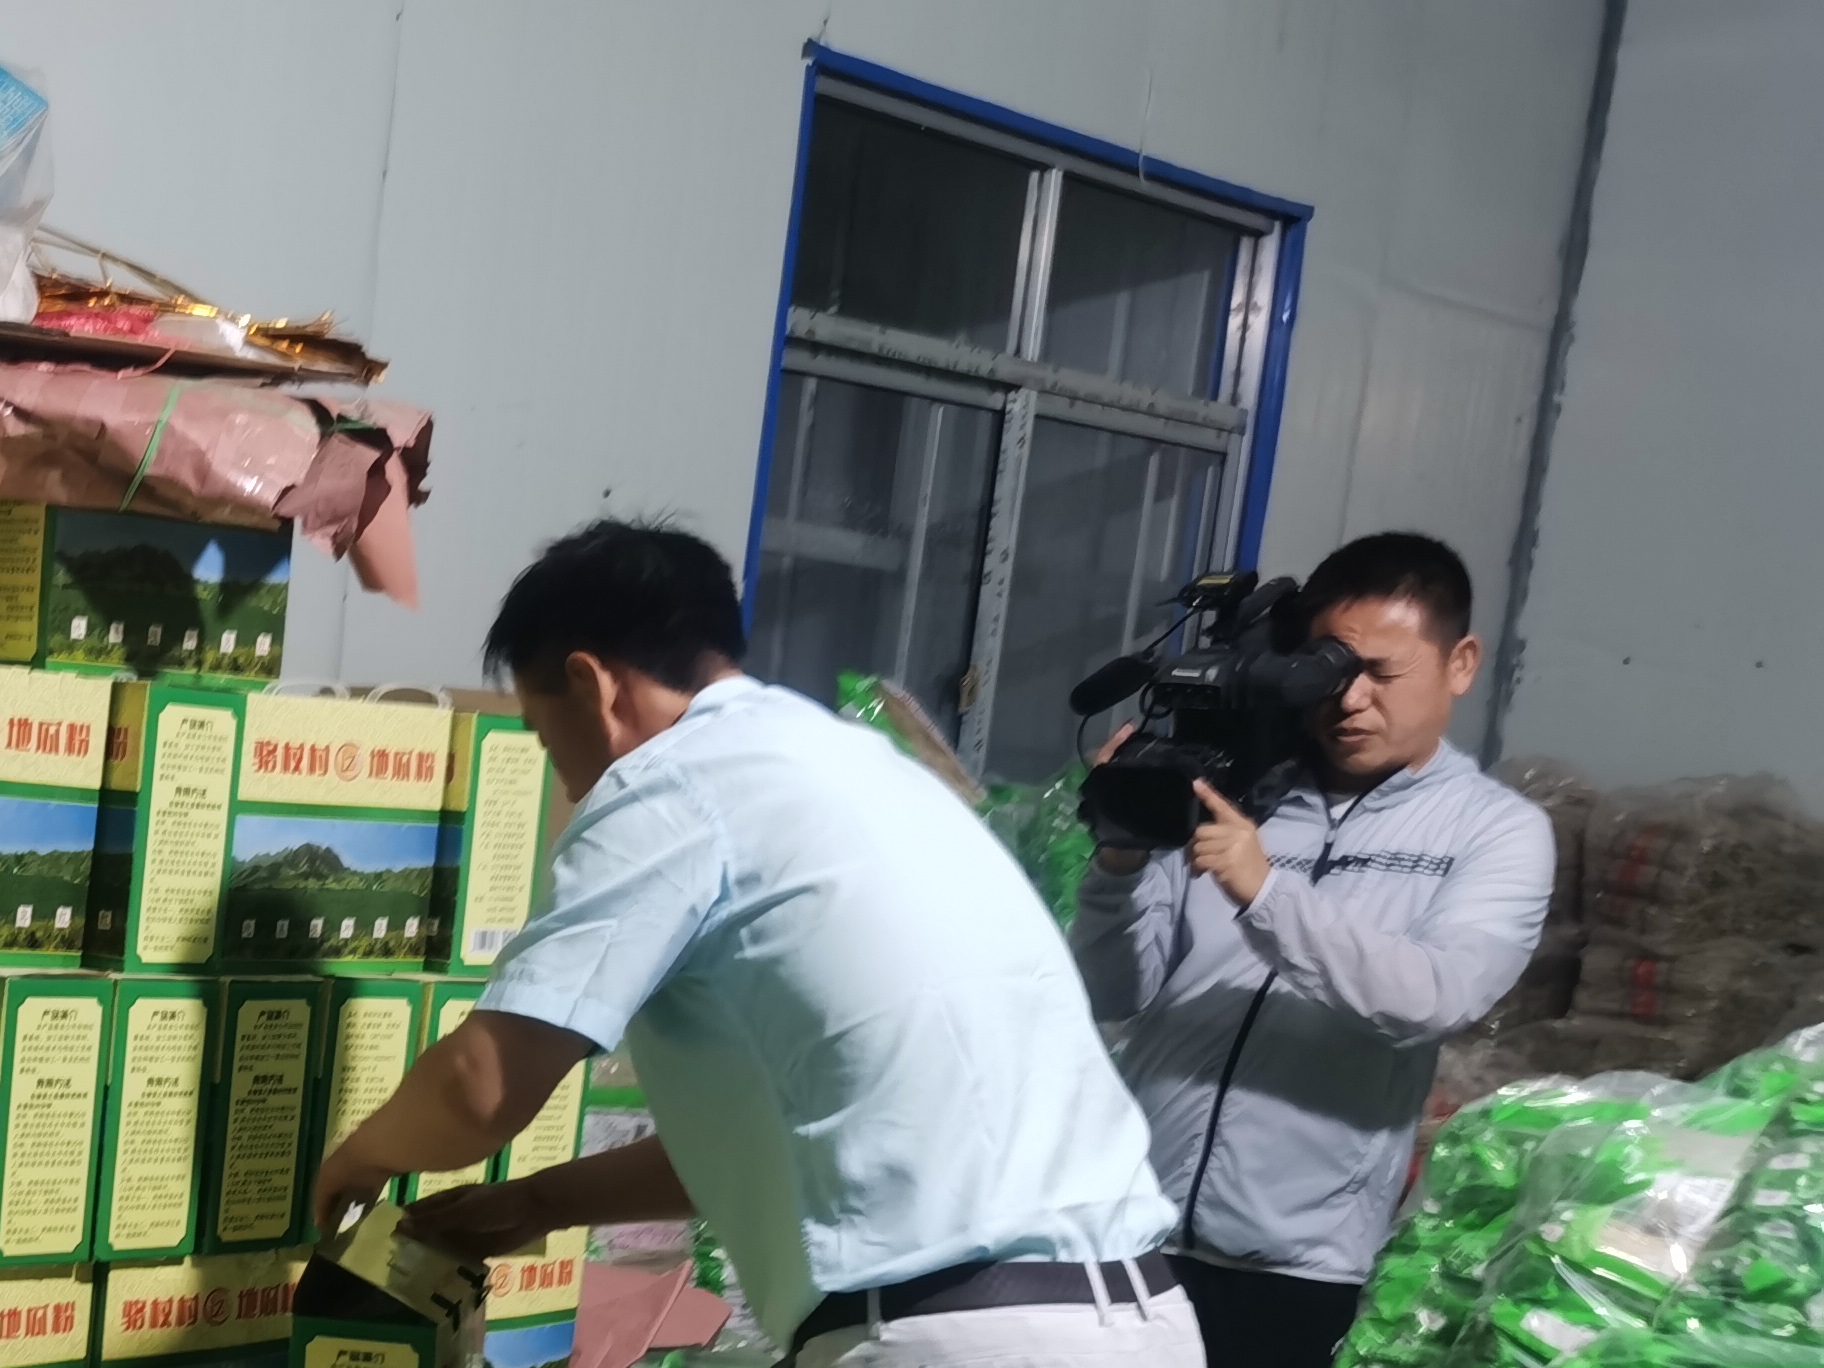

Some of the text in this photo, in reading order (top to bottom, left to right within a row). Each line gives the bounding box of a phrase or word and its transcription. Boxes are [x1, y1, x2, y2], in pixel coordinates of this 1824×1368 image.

[5, 717, 91, 758] 地瓜粉
[253, 740, 438, 783] 骆杖村 地瓜粉
